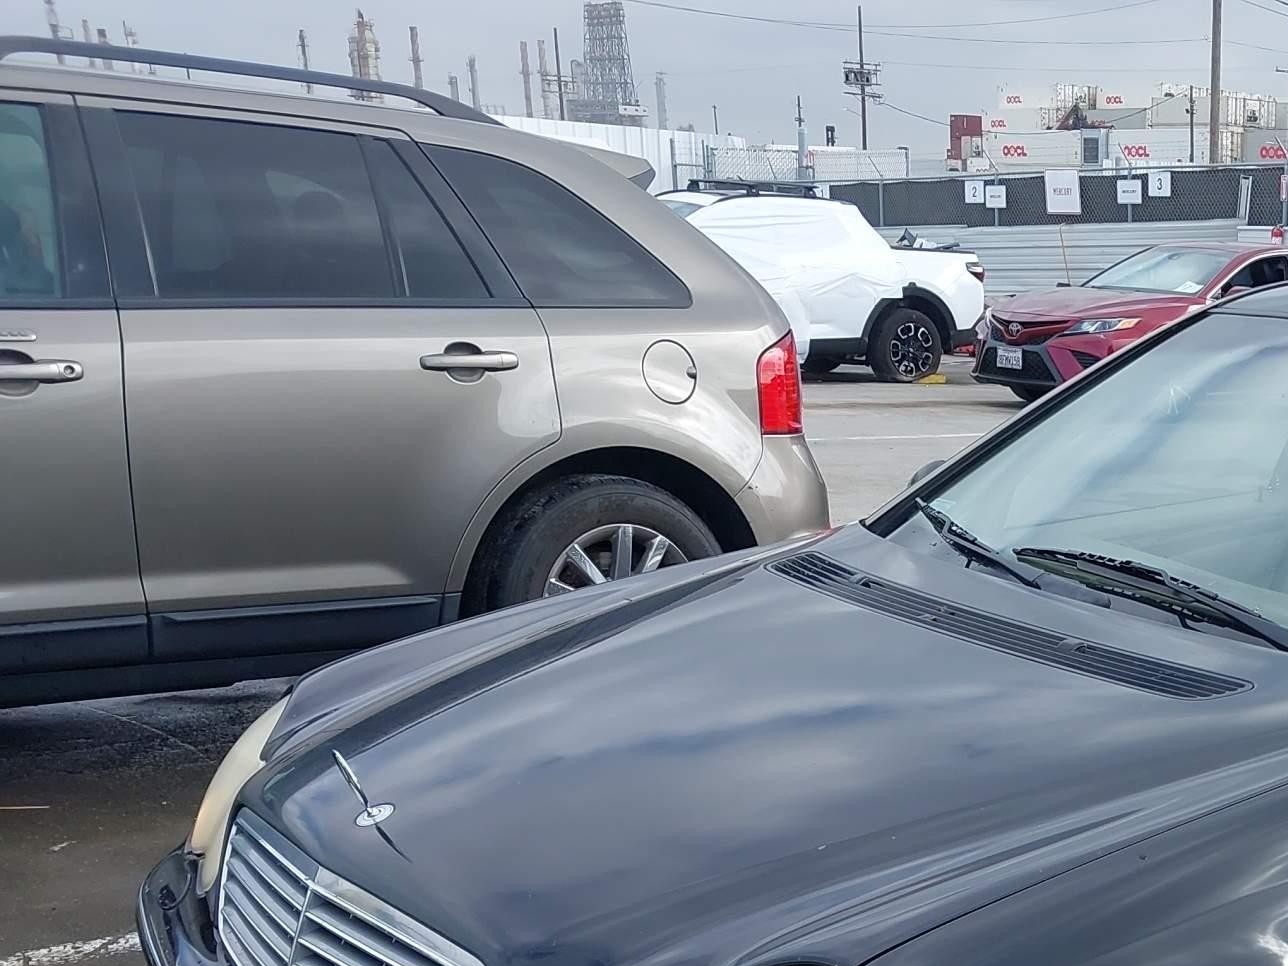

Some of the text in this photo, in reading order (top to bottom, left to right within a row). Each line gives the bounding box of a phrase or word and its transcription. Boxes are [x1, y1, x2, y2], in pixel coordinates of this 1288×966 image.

[1006, 95, 1022, 104] OOCL
[1106, 95, 1123, 104] OOCL
[991, 119, 1007, 128] OOCL
[1002, 145, 1028, 157] OOCL
[1124, 145, 1150, 157] OOCL
[1156, 178, 1163, 191] 3
[971, 186, 977, 198] 2
[1052, 187, 1072, 196] MERCURY
